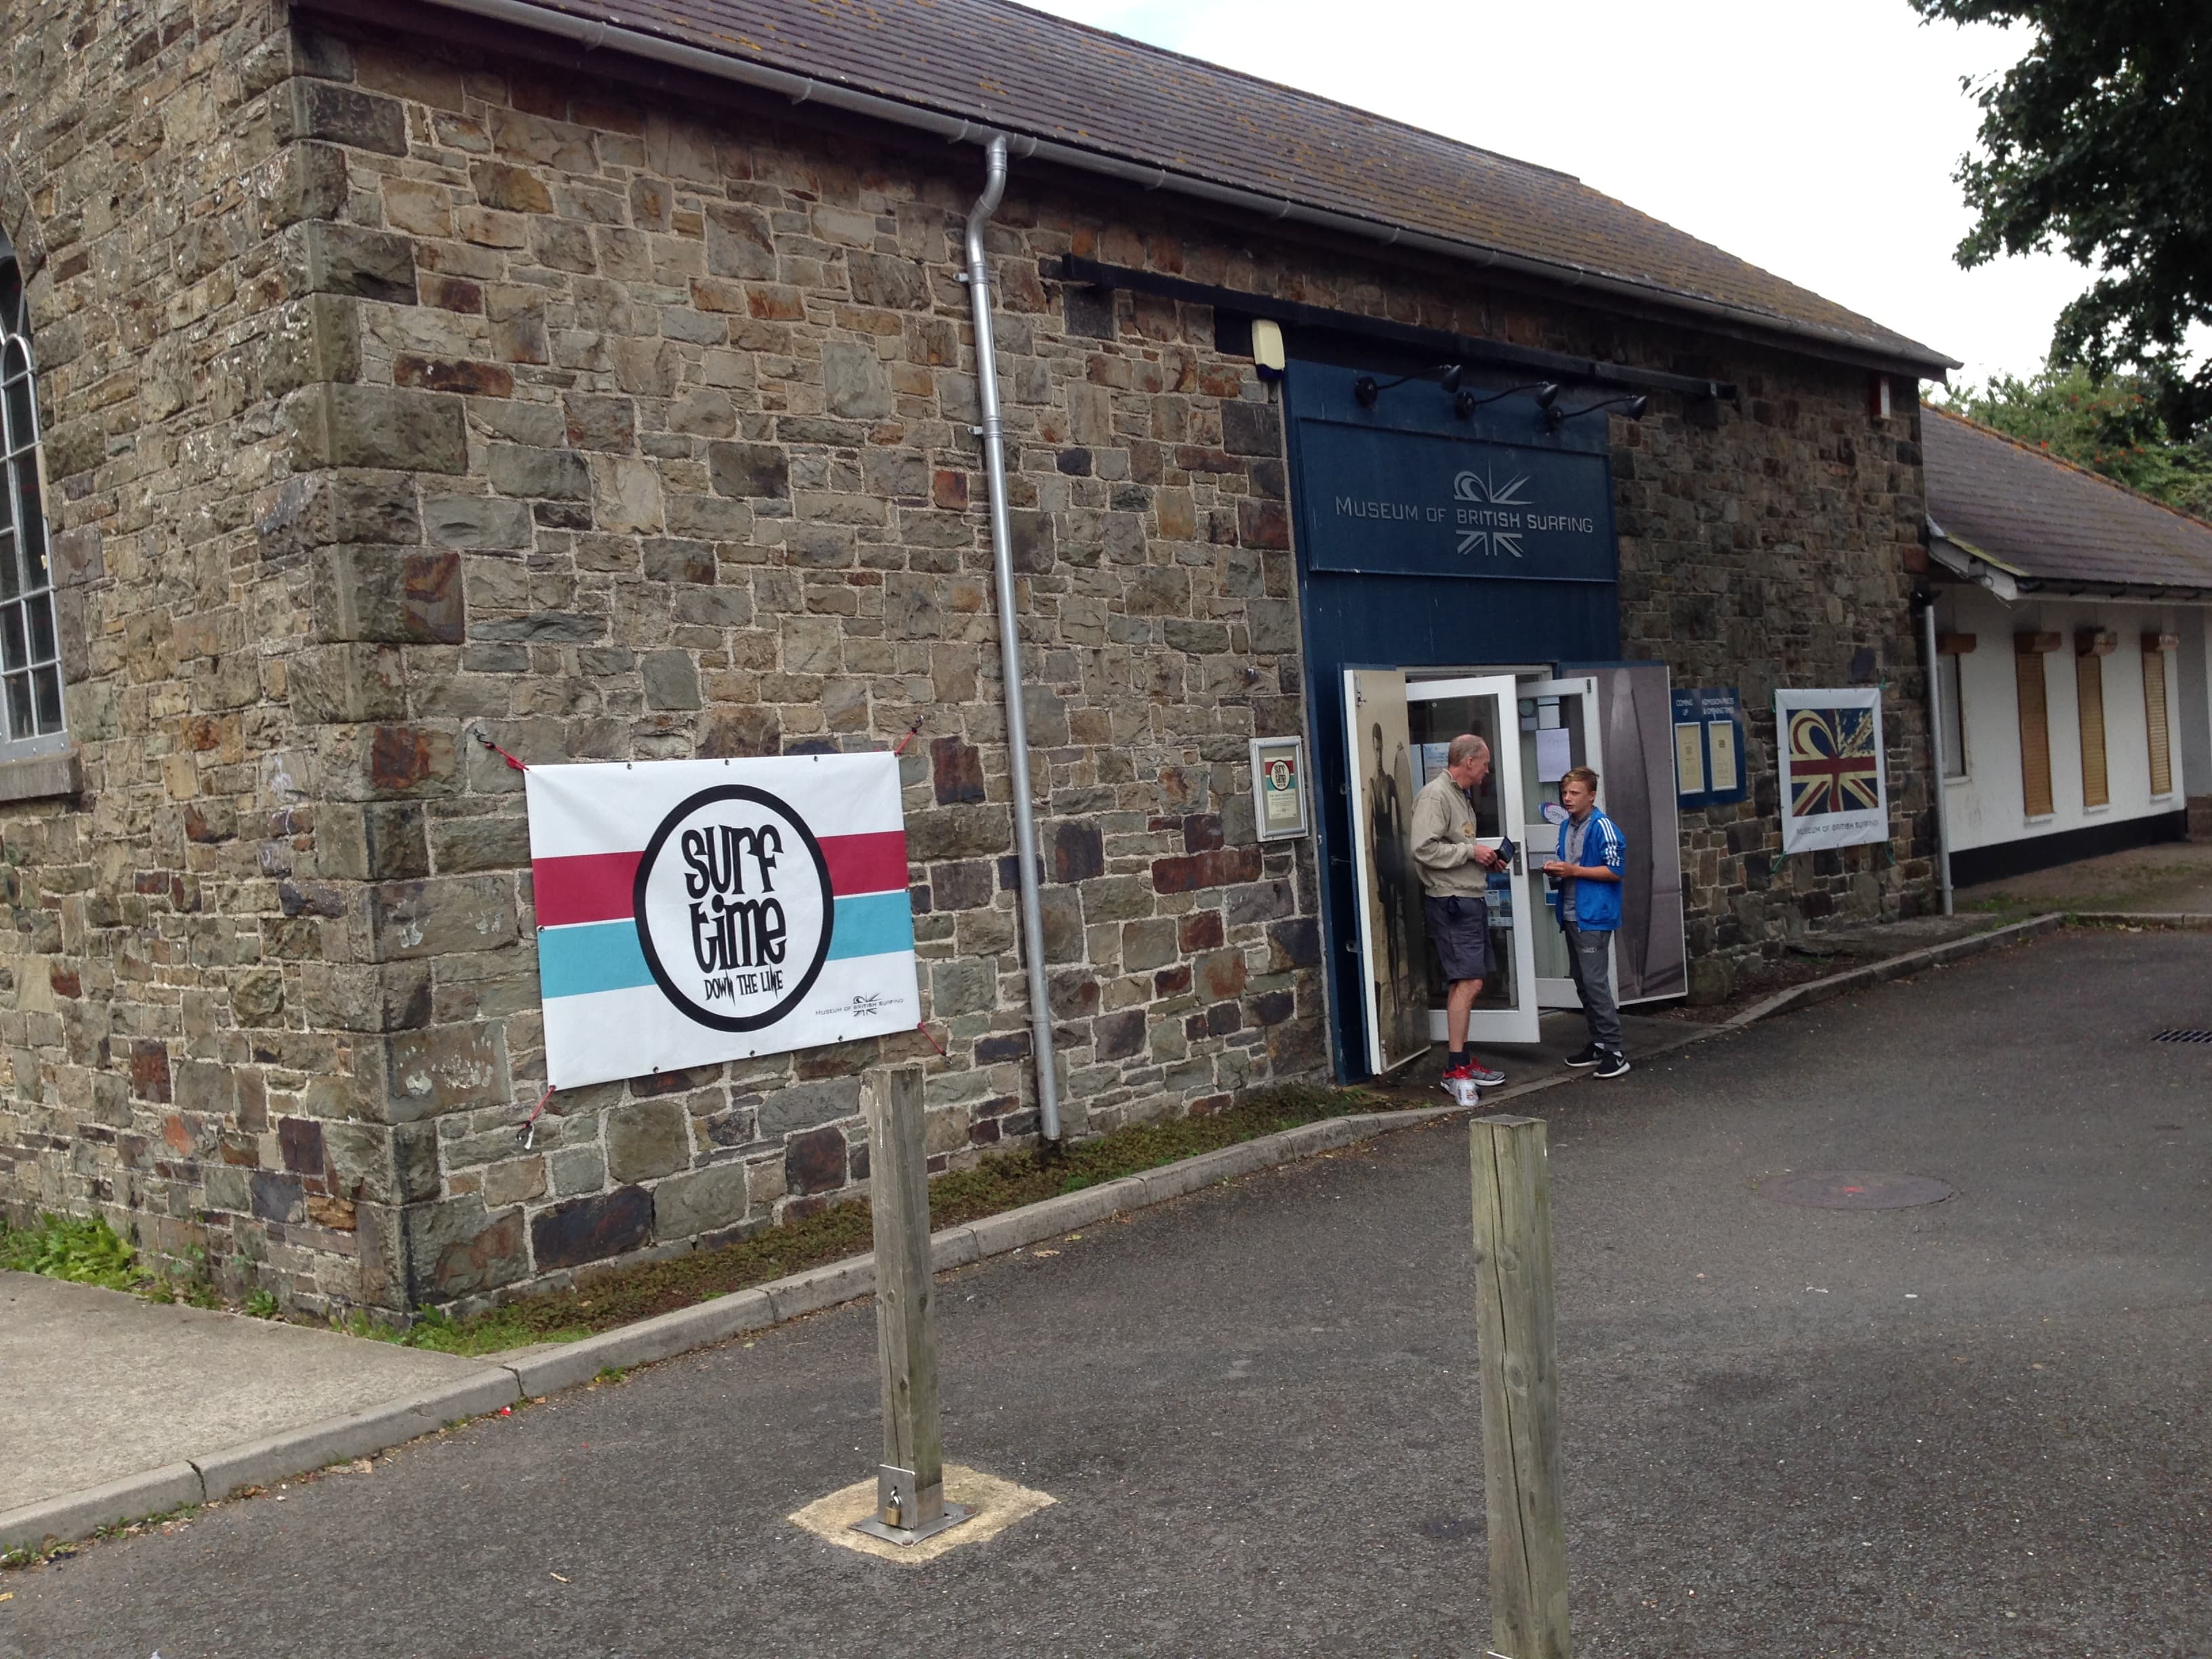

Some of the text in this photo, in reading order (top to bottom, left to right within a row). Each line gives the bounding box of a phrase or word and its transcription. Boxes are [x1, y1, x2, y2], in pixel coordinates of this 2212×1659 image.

[1336, 495, 1593, 533] MUSEUM OF BRITISH SURFING
[703, 964, 783, 1006] DOWN THE LINE
